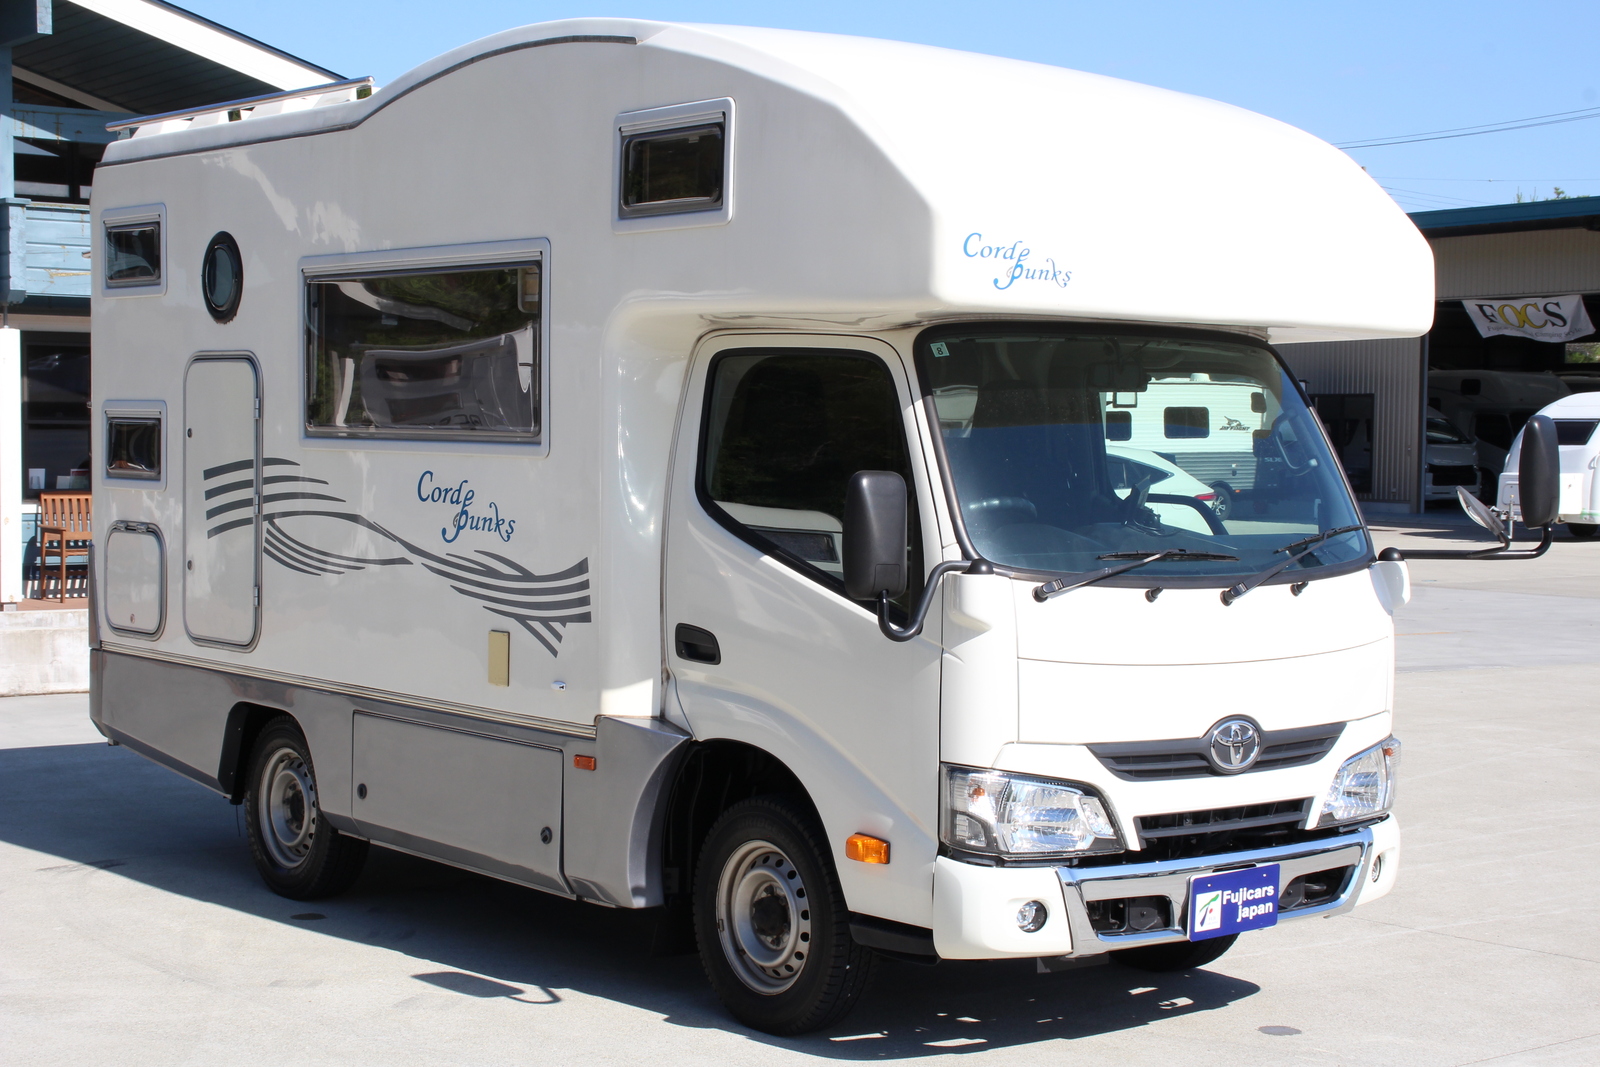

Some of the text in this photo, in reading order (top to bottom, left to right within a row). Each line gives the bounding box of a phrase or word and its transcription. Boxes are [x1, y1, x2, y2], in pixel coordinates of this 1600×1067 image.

[963, 232, 1030, 262] Corde
[1475, 301, 1567, 329] FOCS
[417, 470, 475, 506] Corde
[1222, 885, 1275, 906] Fujicars
[1236, 902, 1273, 922] japan
